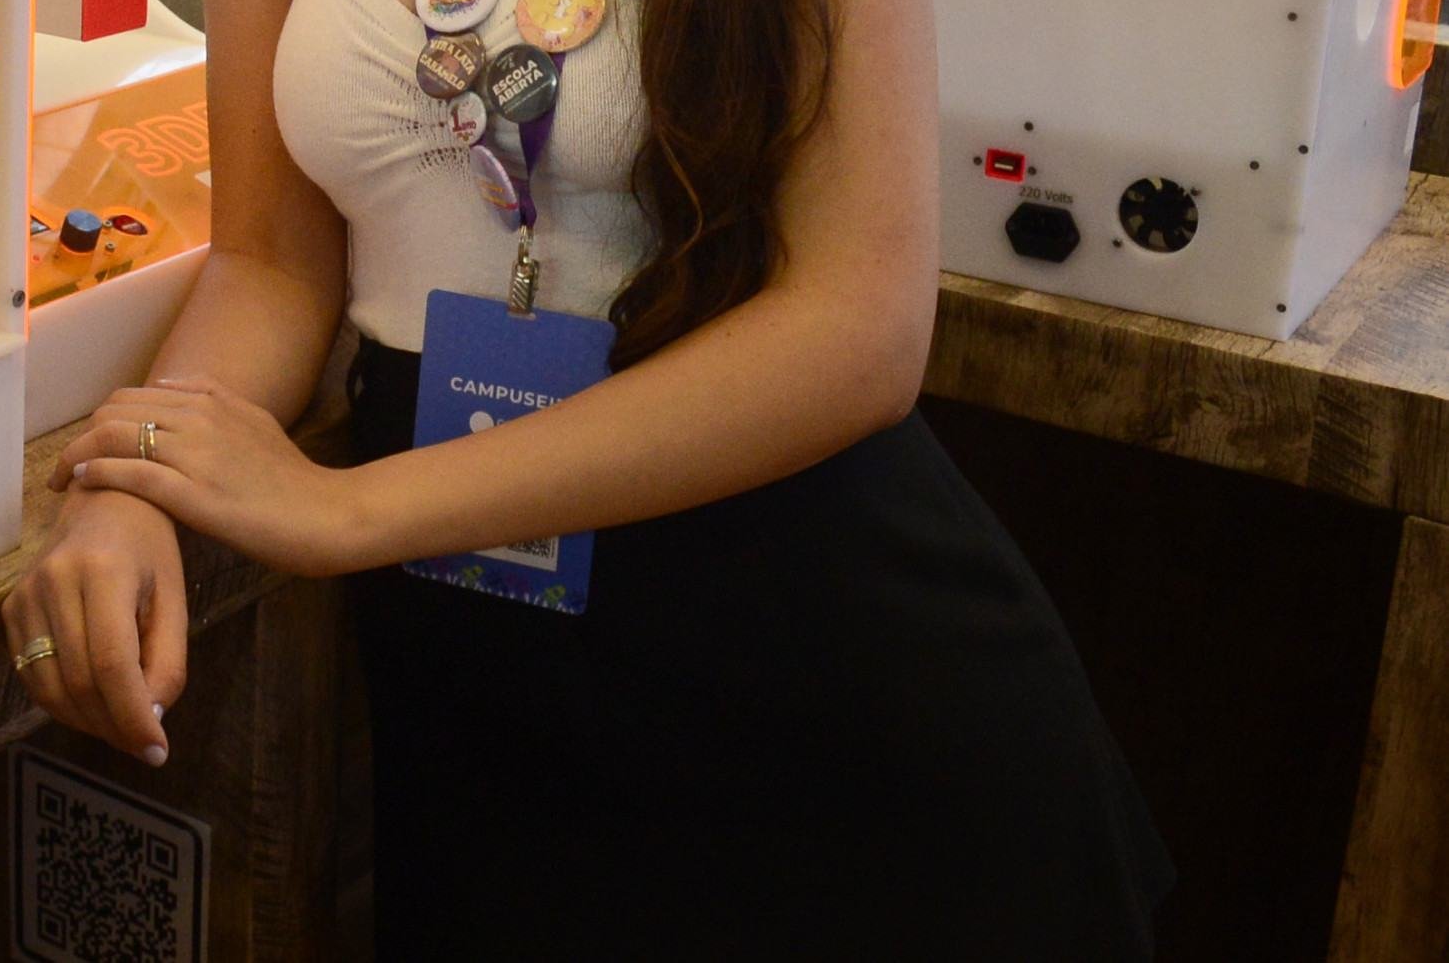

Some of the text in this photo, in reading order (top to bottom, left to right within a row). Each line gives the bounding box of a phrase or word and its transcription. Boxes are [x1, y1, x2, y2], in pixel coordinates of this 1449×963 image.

[419, 53, 466, 91] CARAMELO
[430, 39, 455, 55] VIRA
[454, 49, 476, 75] LATA
[492, 60, 538, 96] ESCOLA
[498, 69, 544, 106] ABERTA
[1019, 186, 1074, 204] 220 Volts
[450, 376, 564, 409] CAMPUSEI
